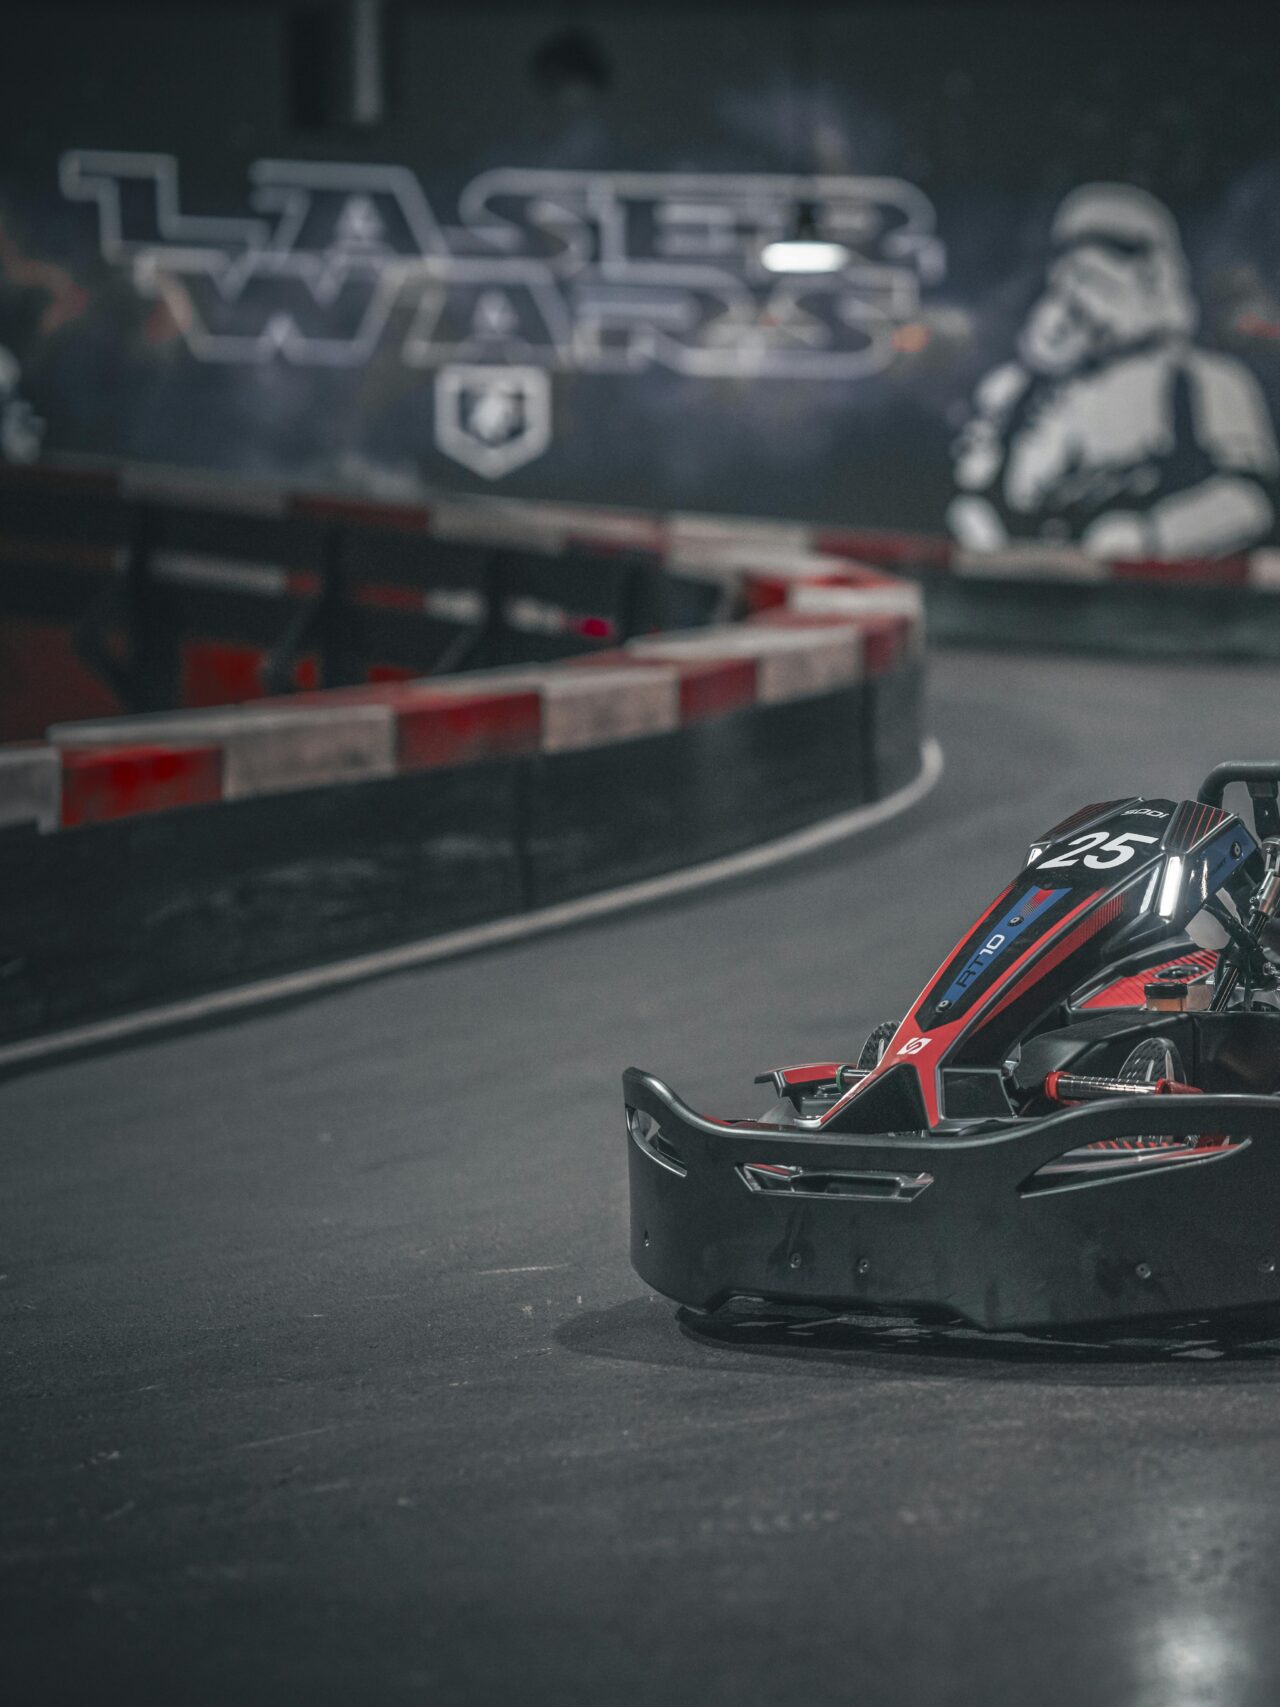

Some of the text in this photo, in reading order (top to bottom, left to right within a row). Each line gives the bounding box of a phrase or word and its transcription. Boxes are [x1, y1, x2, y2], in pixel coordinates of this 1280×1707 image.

[59, 149, 948, 288] LASER
[134, 242, 922, 379] WARS
[1035, 831, 1160, 870] 25
[955, 934, 1006, 988] RT10
